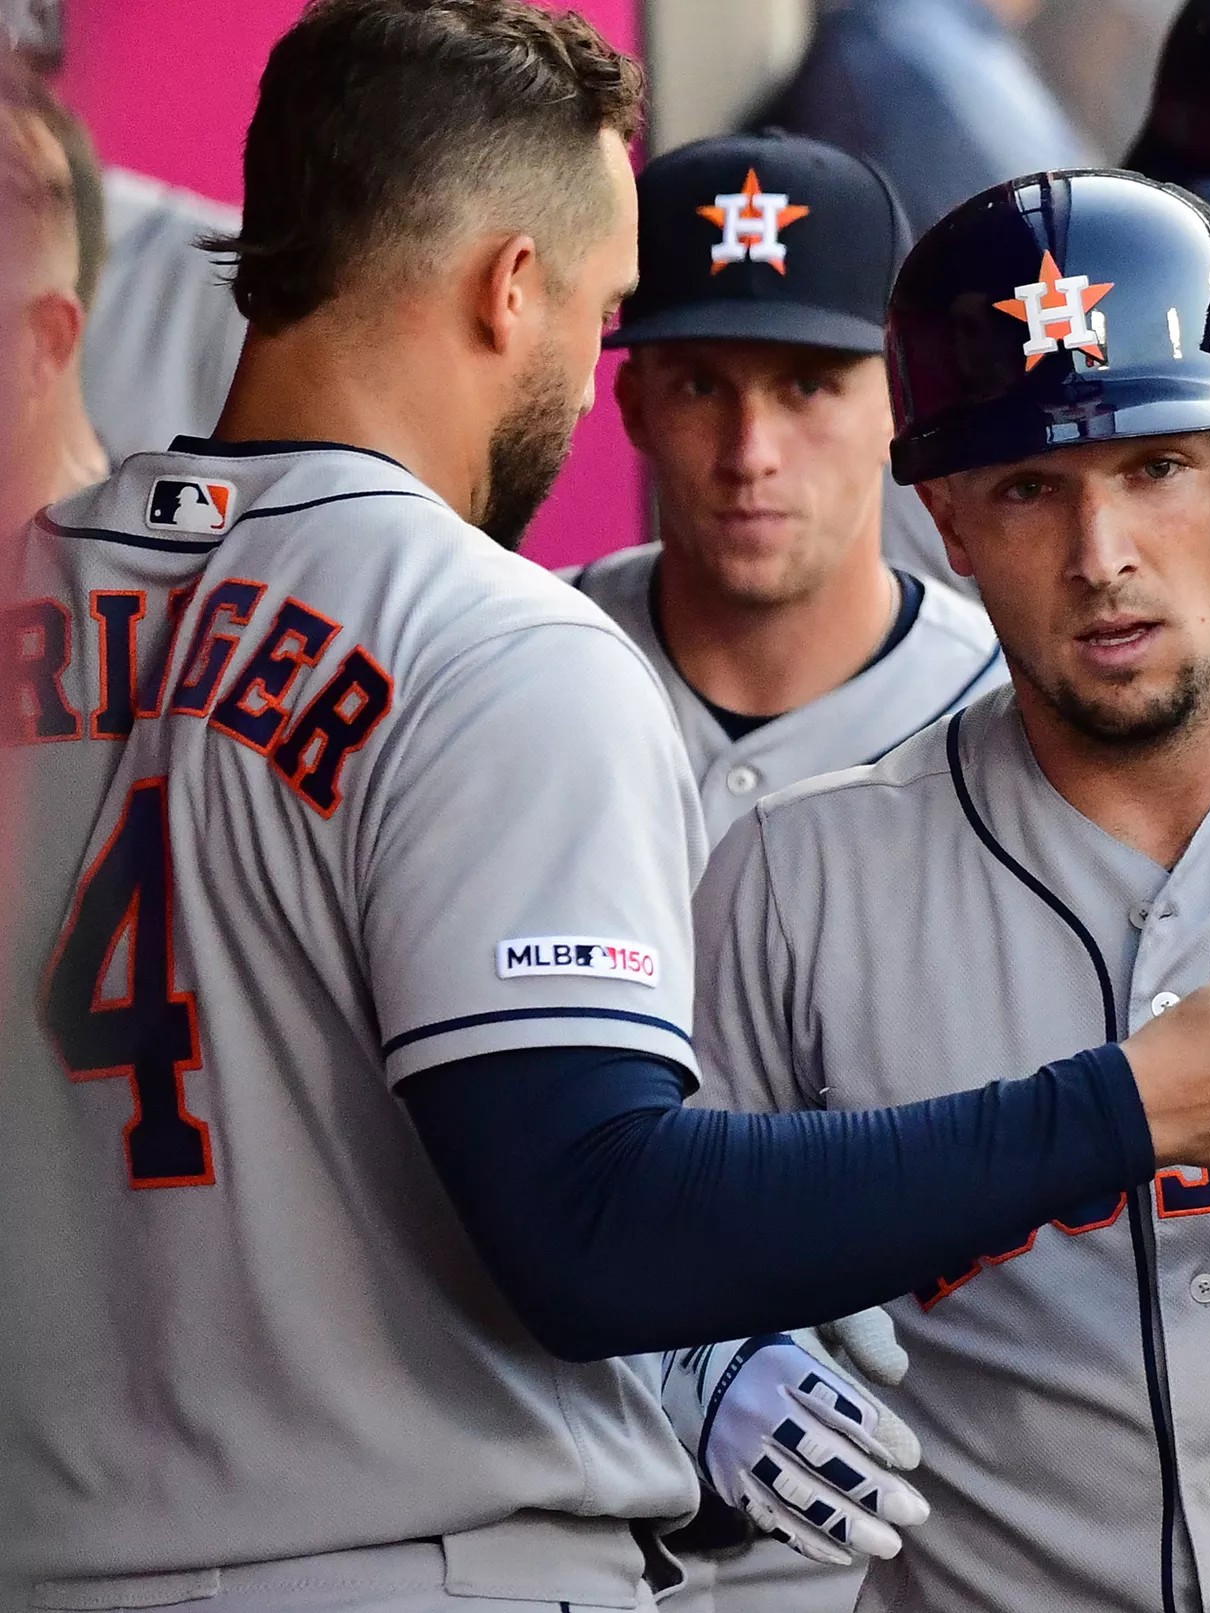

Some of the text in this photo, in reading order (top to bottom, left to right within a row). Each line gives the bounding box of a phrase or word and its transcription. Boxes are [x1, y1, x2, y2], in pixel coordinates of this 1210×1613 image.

[711, 193, 788, 262] H
[1014, 275, 1098, 355] H
[40, 775, 216, 1189] 4
[508, 945, 655, 977] MLB 150
